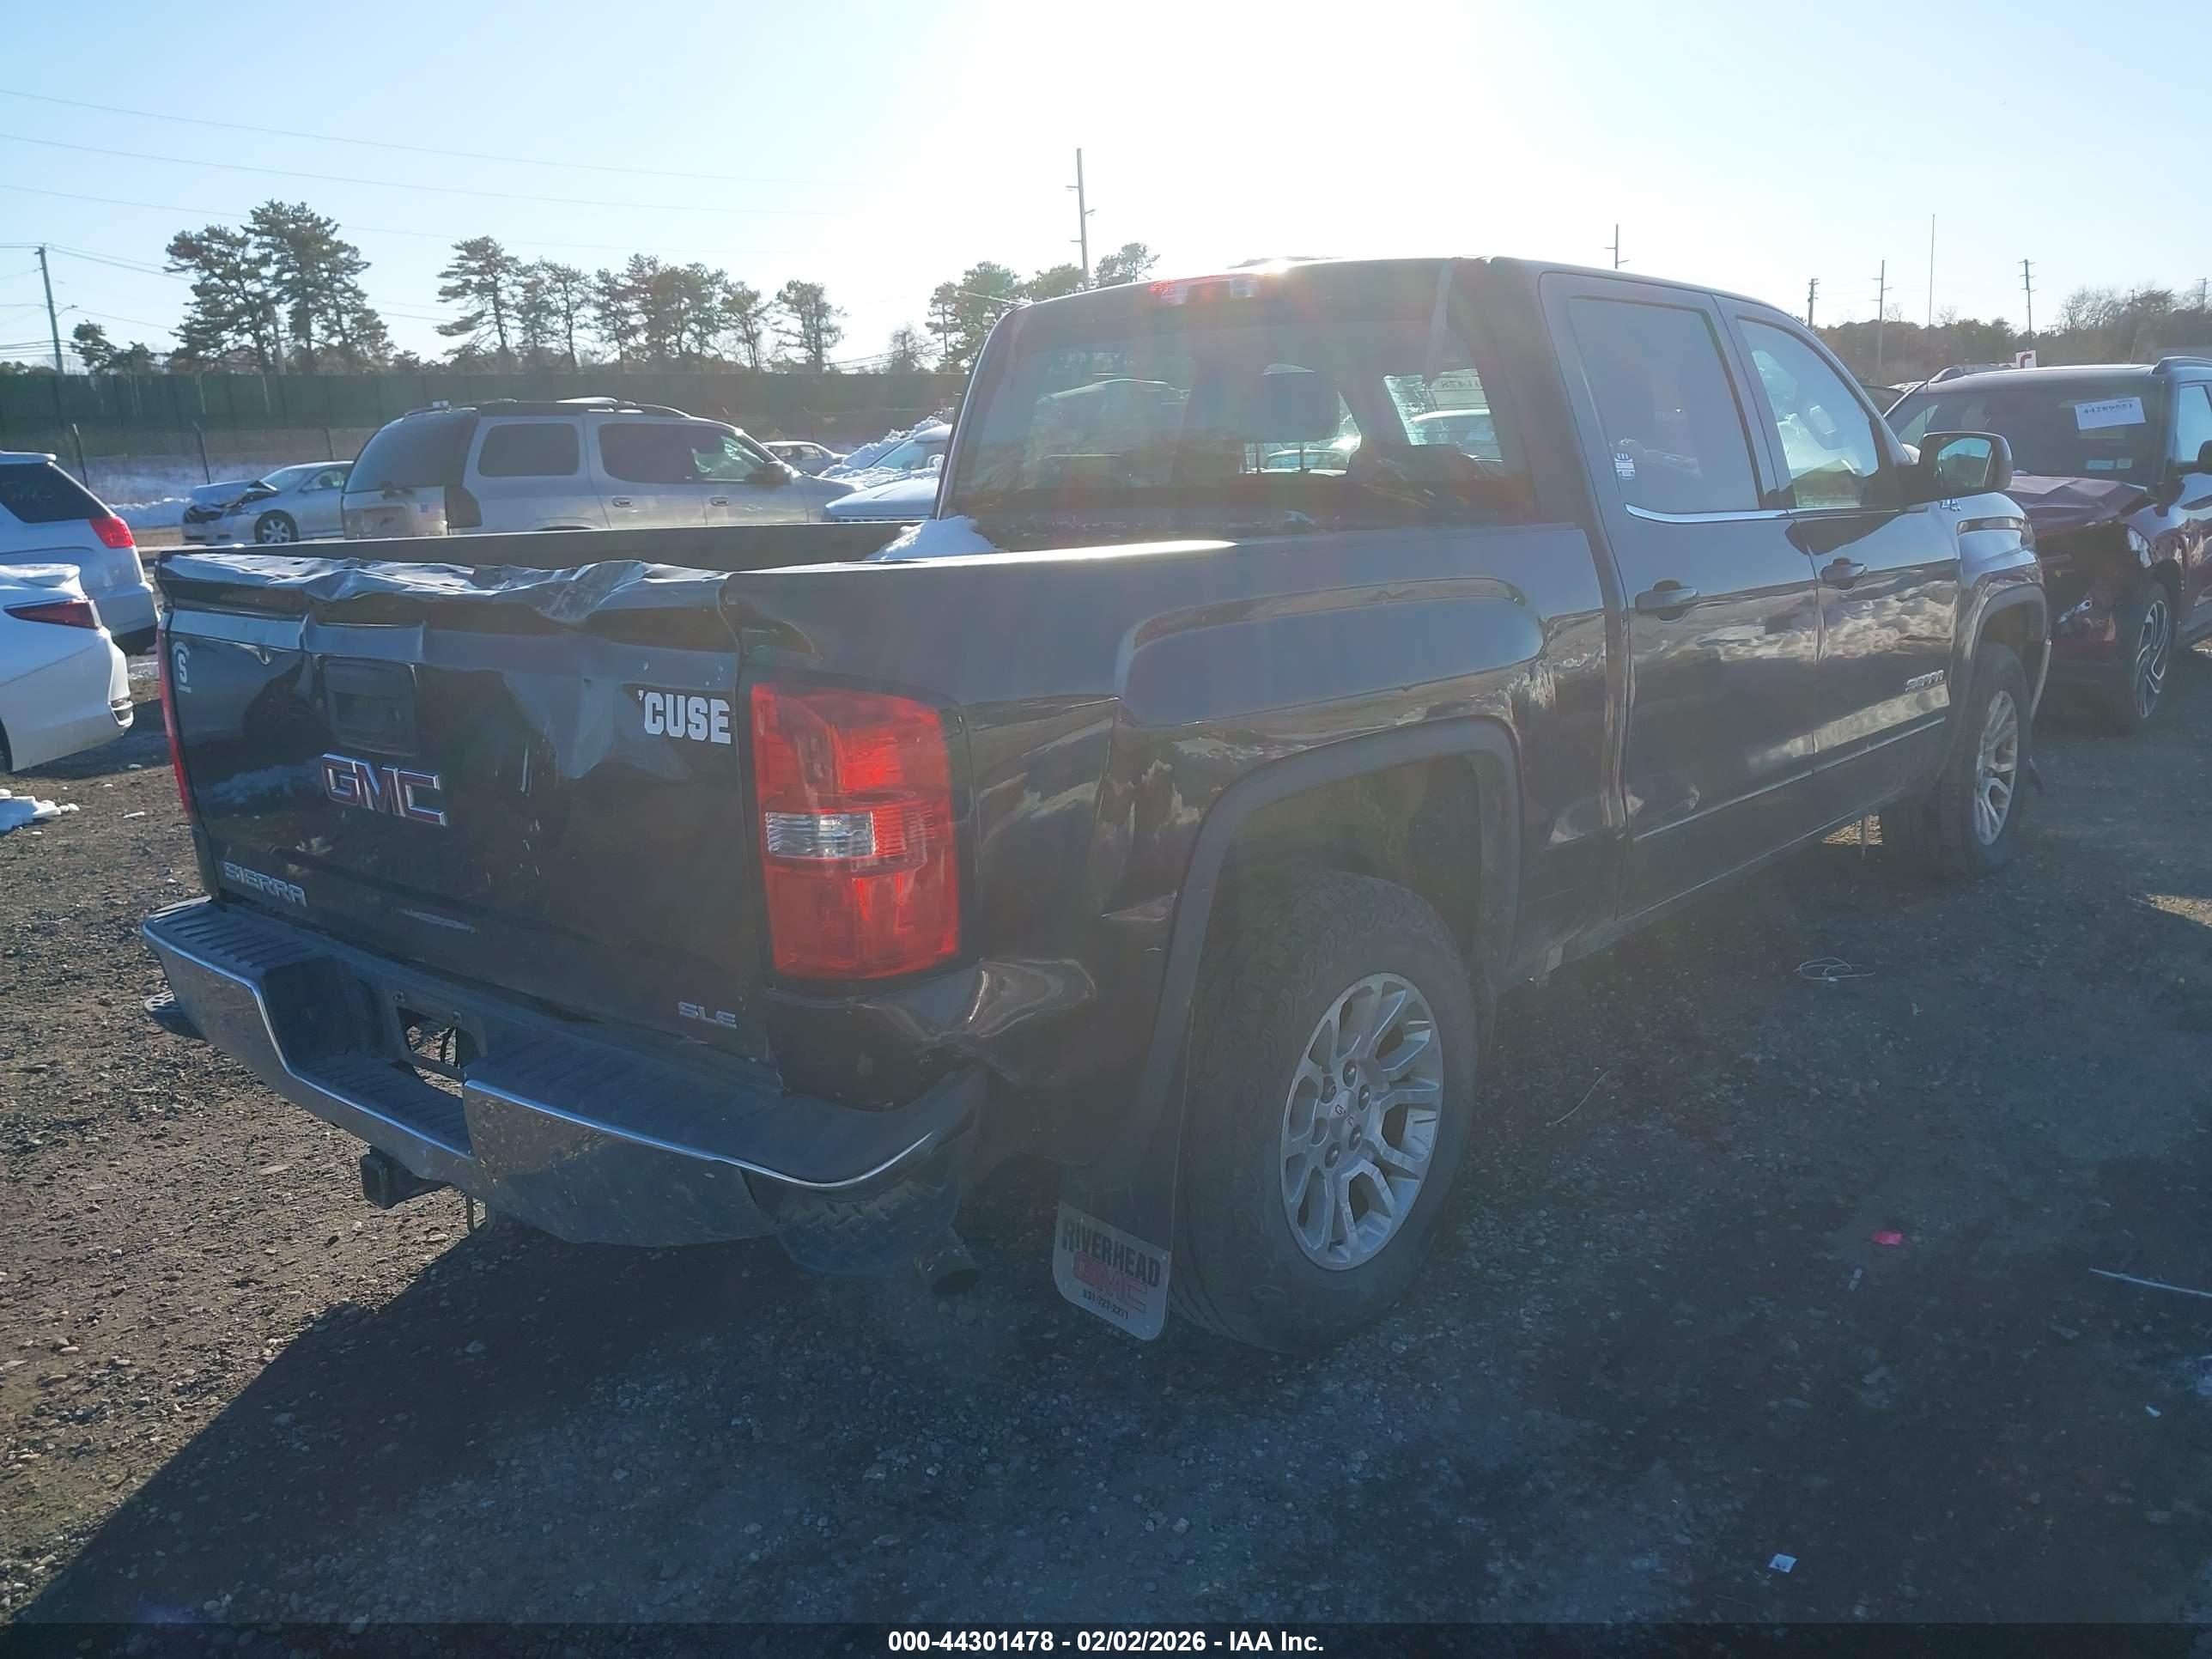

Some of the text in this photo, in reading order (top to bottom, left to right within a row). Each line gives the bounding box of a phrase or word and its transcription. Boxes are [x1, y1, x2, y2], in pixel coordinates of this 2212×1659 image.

[320, 752, 447, 827] GMC
[222, 860, 307, 908] SIERRA
[678, 1000, 738, 1029] SLE
[1334, 1104, 1355, 1127] GMC
[1061, 1217, 1161, 1288] RIVERHEAD
